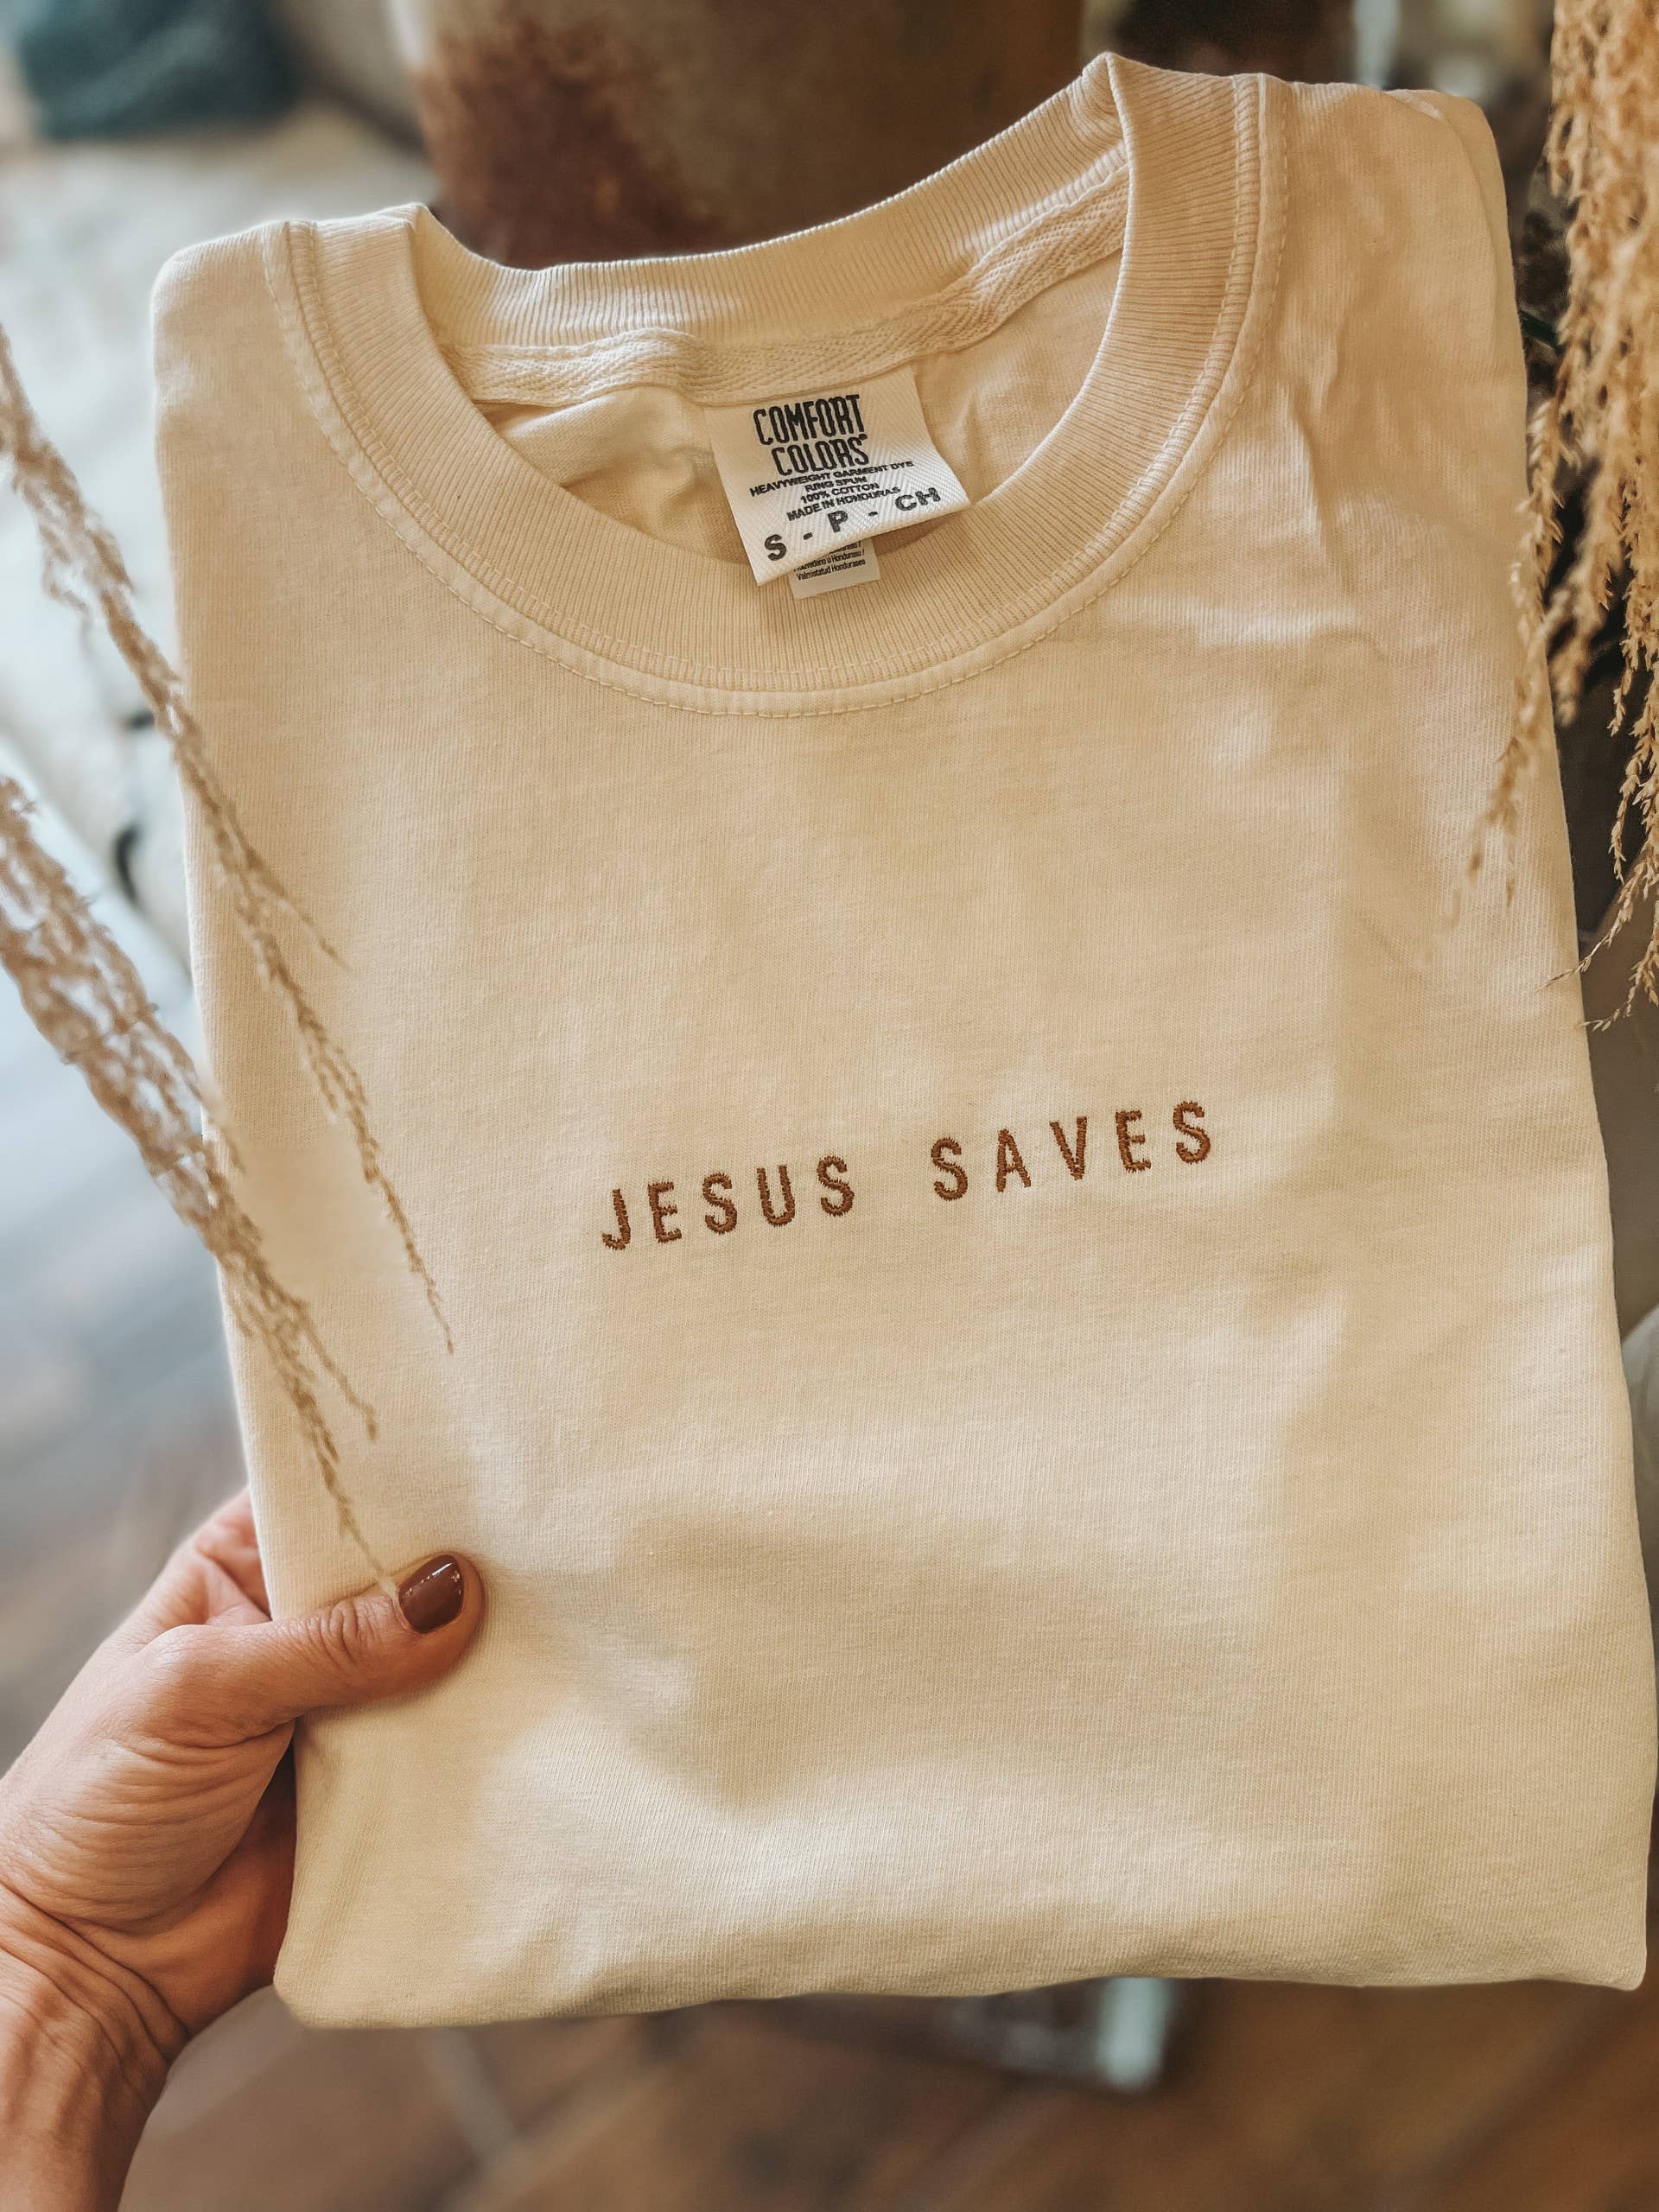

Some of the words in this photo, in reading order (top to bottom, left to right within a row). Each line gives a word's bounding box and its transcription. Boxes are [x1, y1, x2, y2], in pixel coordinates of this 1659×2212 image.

[753, 394, 867, 445] COMFORT
[749, 472, 831, 497] HEAVYWEIGHT
[832, 465, 888, 478] GARMENT
[891, 461, 915, 470] DYE
[801, 491, 830, 504] 100%
[831, 483, 880, 495] COTTON
[804, 480, 834, 493] RING
[836, 476, 868, 486] SPUN
[787, 503, 822, 521] MADE
[821, 499, 835, 510] IN
[836, 486, 901, 505] HONDURAS
[764, 534, 787, 562] S
[828, 511, 849, 533] P
[894, 487, 942, 512] CH
[602, 1155, 855, 1250] JESUS
[931, 1101, 1211, 1200] SAVES
